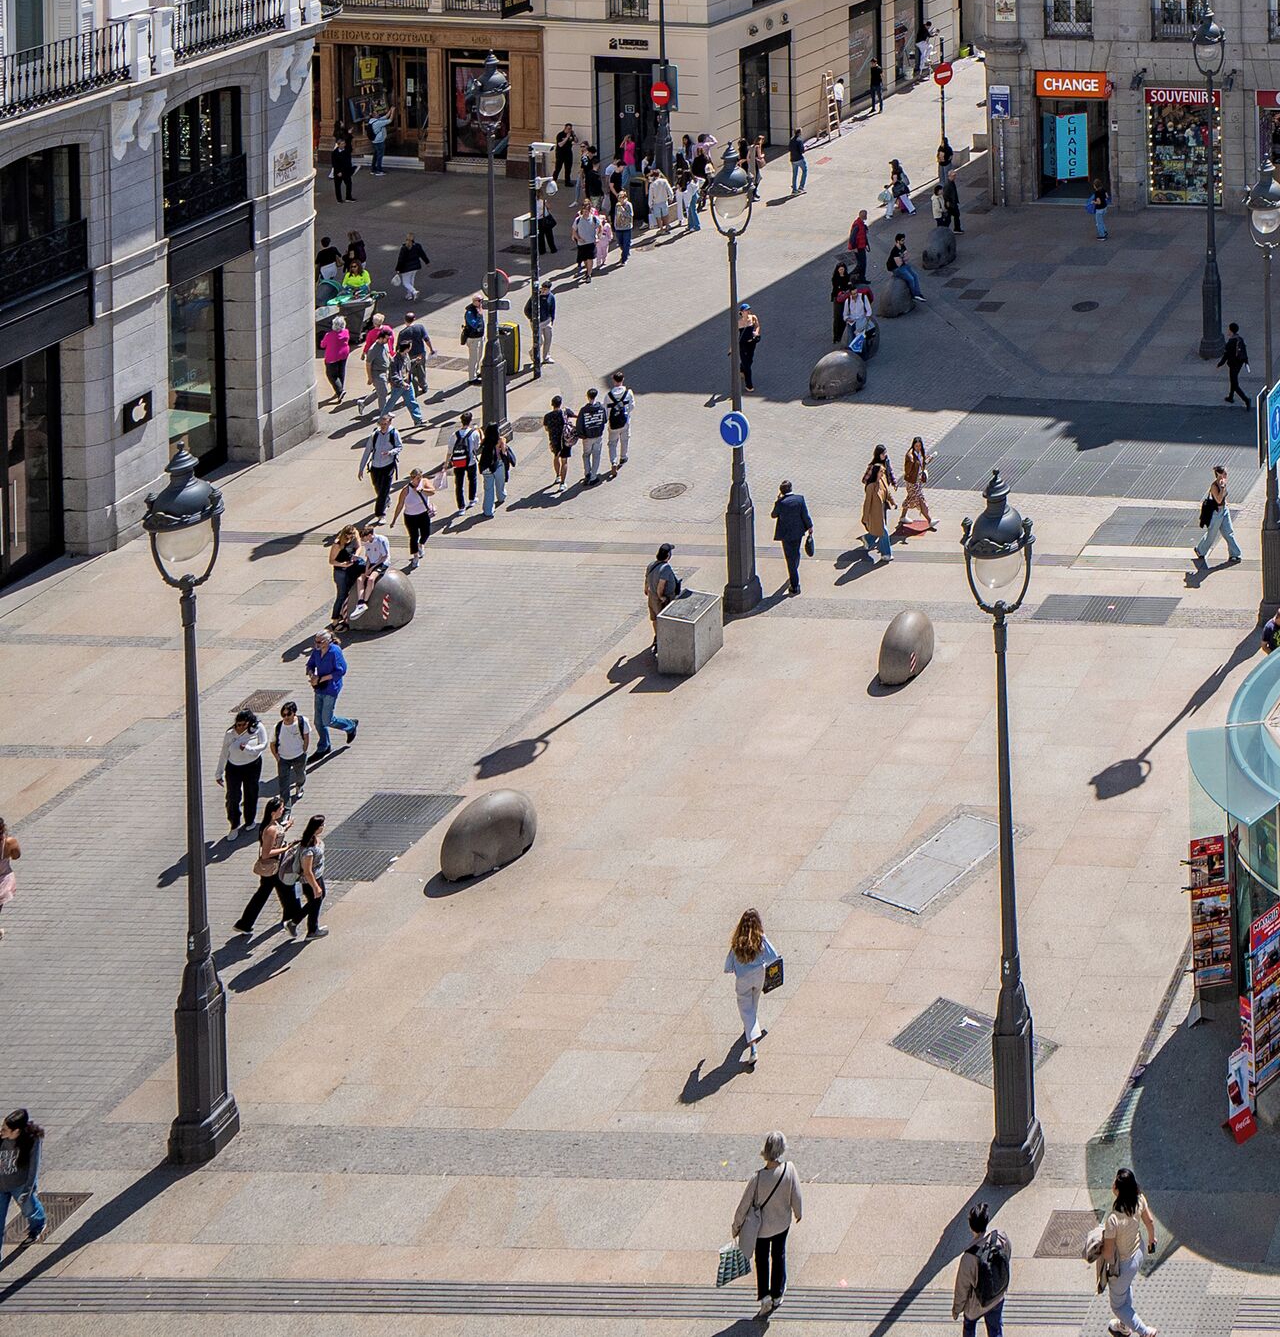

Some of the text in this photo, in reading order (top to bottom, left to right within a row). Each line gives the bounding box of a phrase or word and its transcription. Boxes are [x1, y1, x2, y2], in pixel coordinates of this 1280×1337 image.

[341, 30, 371, 41] HOME
[372, 31, 385, 41] OF
[386, 31, 437, 43] FOOTBALL
[1043, 78, 1100, 92] CHANGE
[1150, 90, 1216, 104] SOUVENIRS
[1067, 116, 1077, 177] CHANGE
[1252, 906, 1280, 935] MADRID
